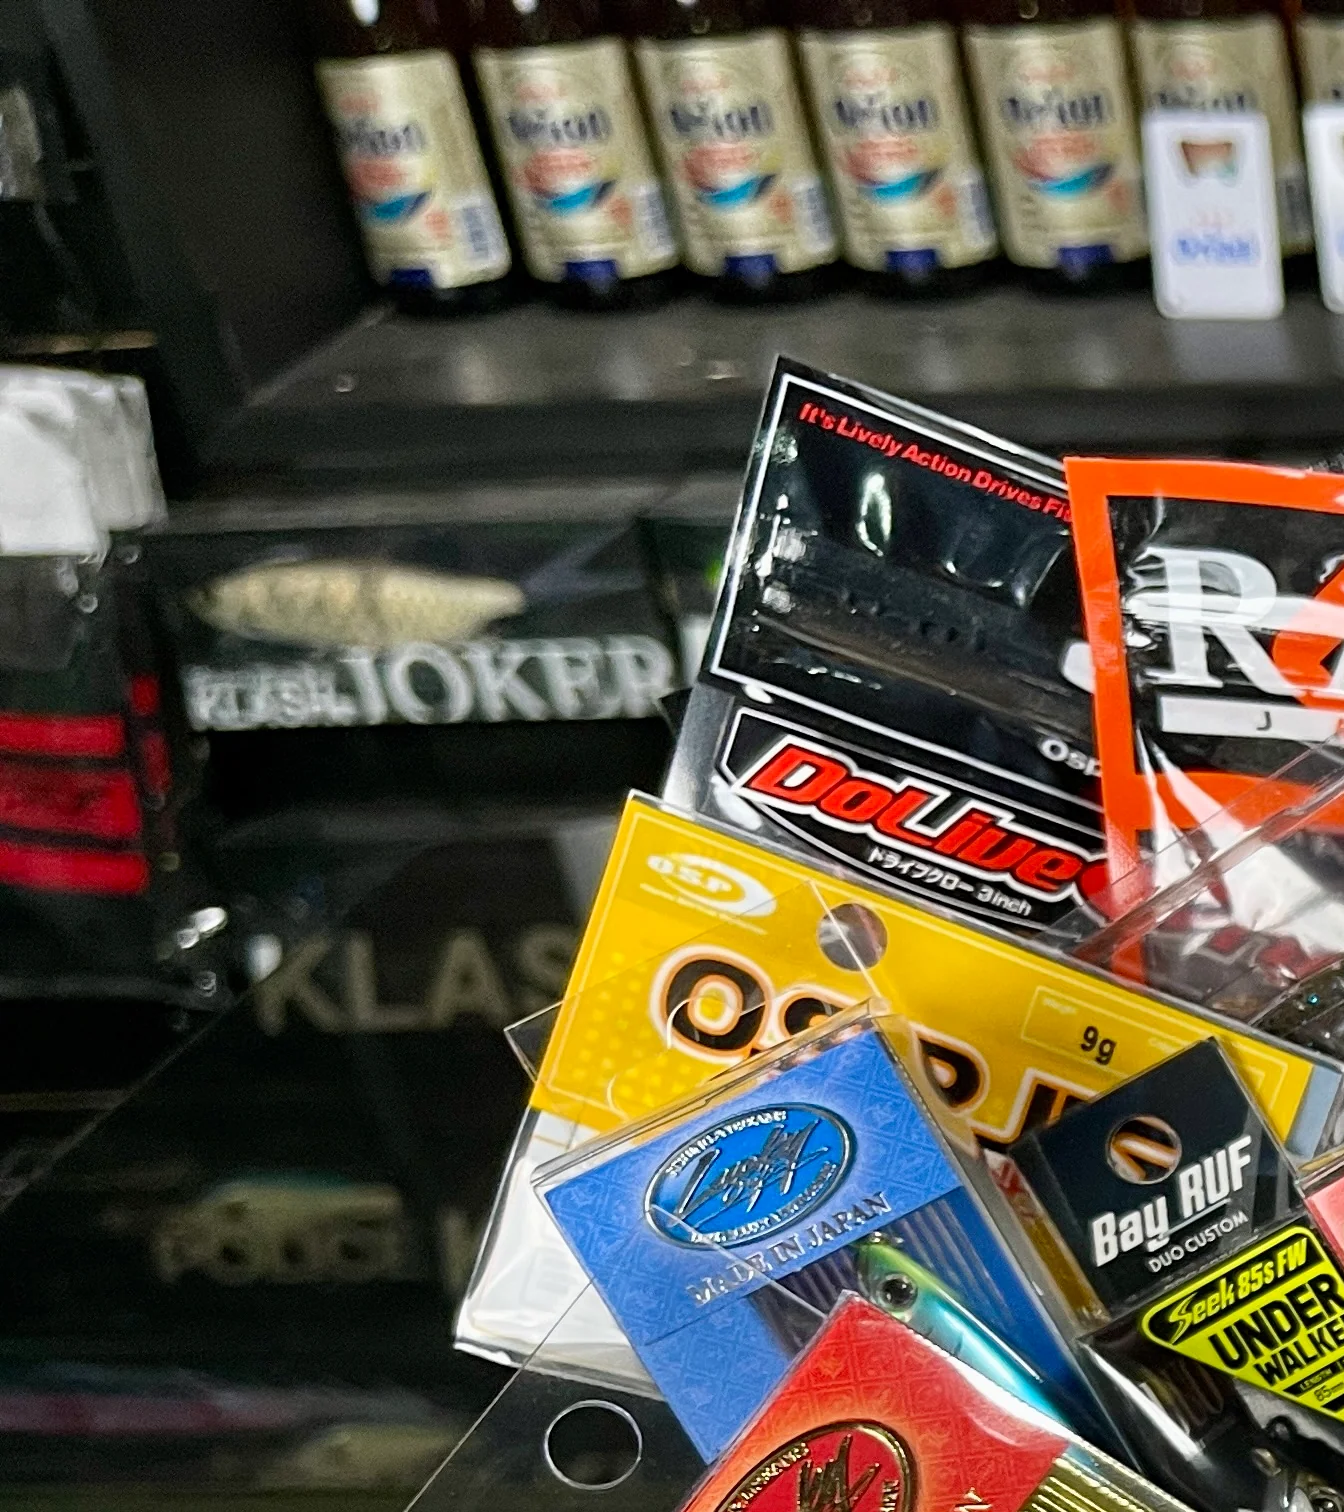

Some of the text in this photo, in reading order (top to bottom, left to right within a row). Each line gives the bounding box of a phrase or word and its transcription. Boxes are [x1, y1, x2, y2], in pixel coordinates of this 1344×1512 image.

[799, 401, 837, 434] It's
[836, 418, 903, 460] Lively
[902, 440, 972, 486] Action
[970, 465, 1042, 513] Drives
[333, 634, 676, 726] JOKER
[976, 884, 1033, 918] 3inch
[1079, 1024, 1121, 1065] 9g
[804, 1190, 893, 1249] JAPAN
[1091, 1193, 1169, 1268] Bay
[1176, 1133, 1255, 1226] RUF
[1148, 1210, 1250, 1274] DUO CUSTOM
[1167, 1277, 1236, 1345] Seek
[1274, 1237, 1309, 1279] FW
